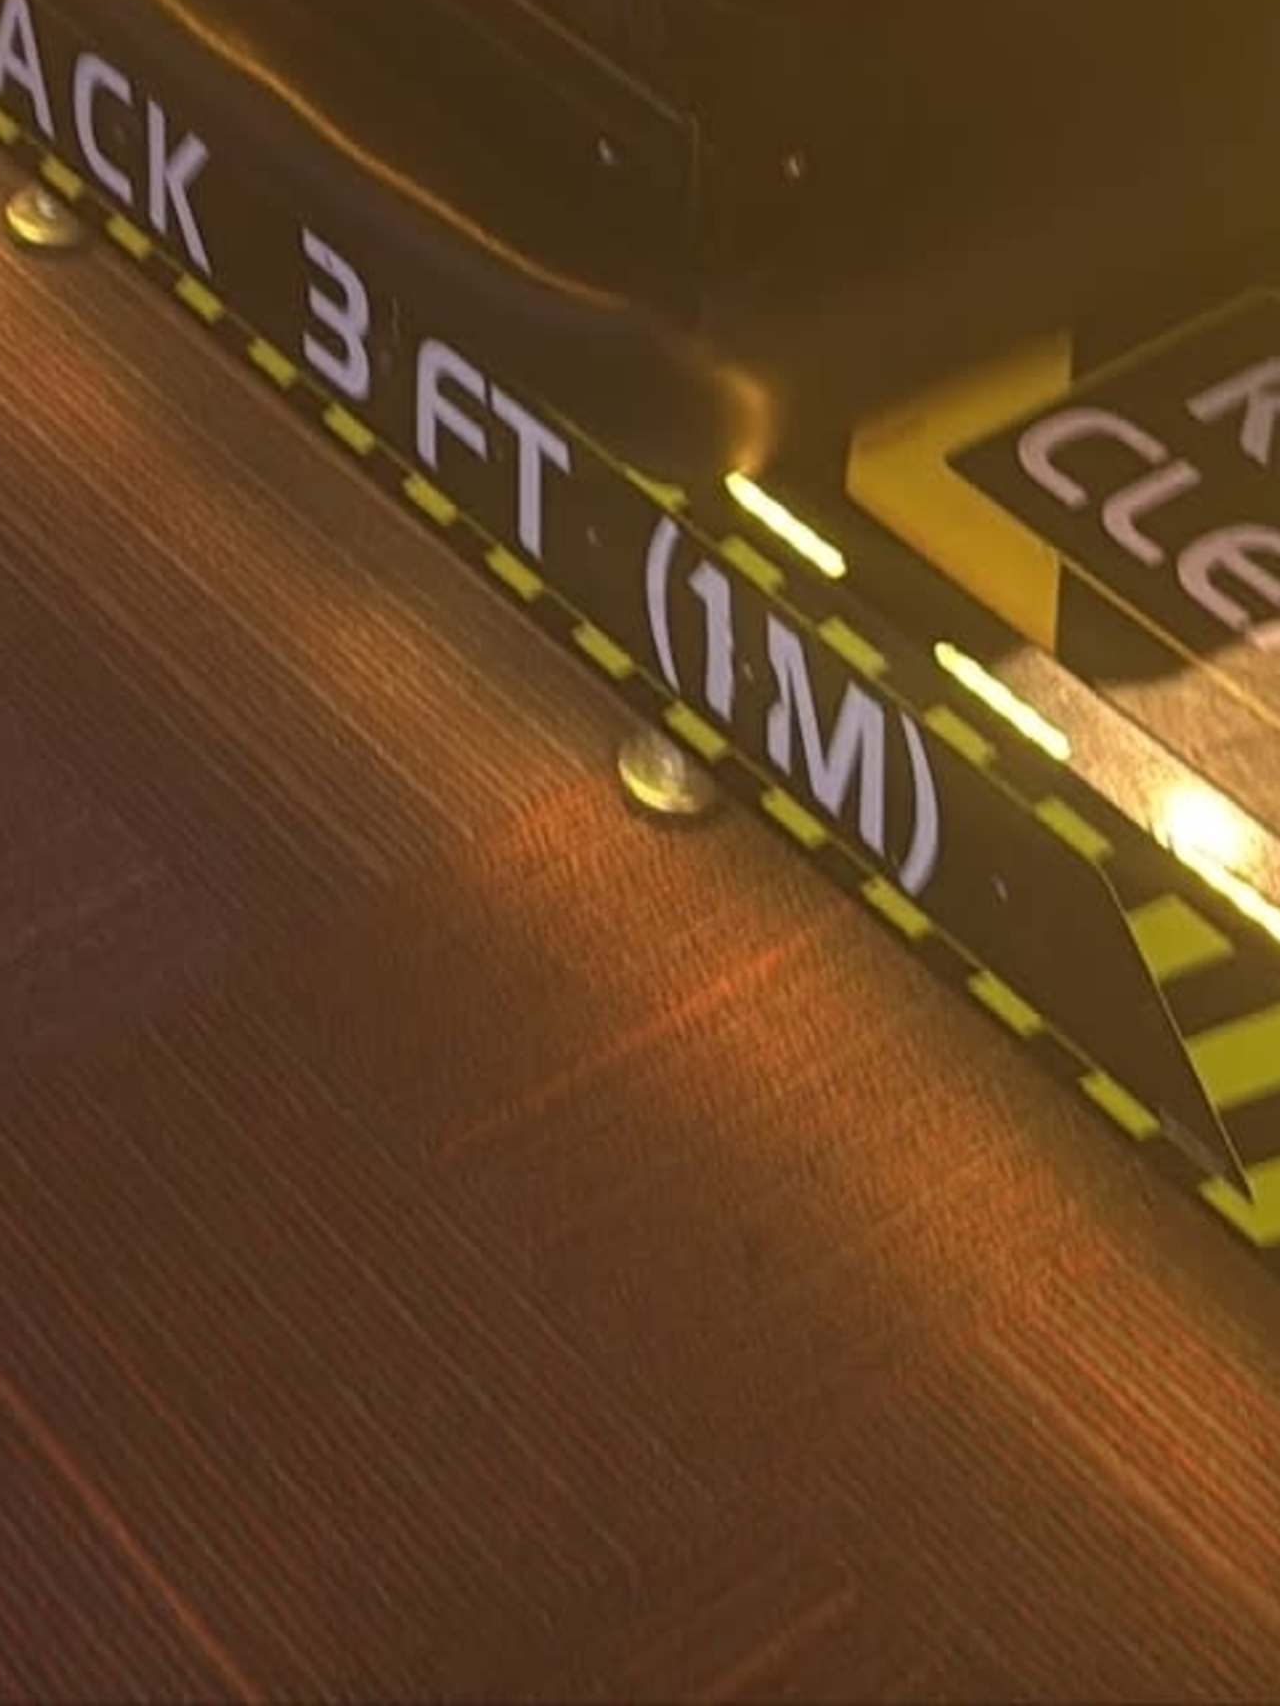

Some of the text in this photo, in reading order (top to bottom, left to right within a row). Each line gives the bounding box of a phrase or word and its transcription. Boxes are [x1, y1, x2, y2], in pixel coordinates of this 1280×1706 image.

[302, 226, 370, 400] 3
[417, 337, 570, 561] FT
[645, 514, 940, 897] (1M)
